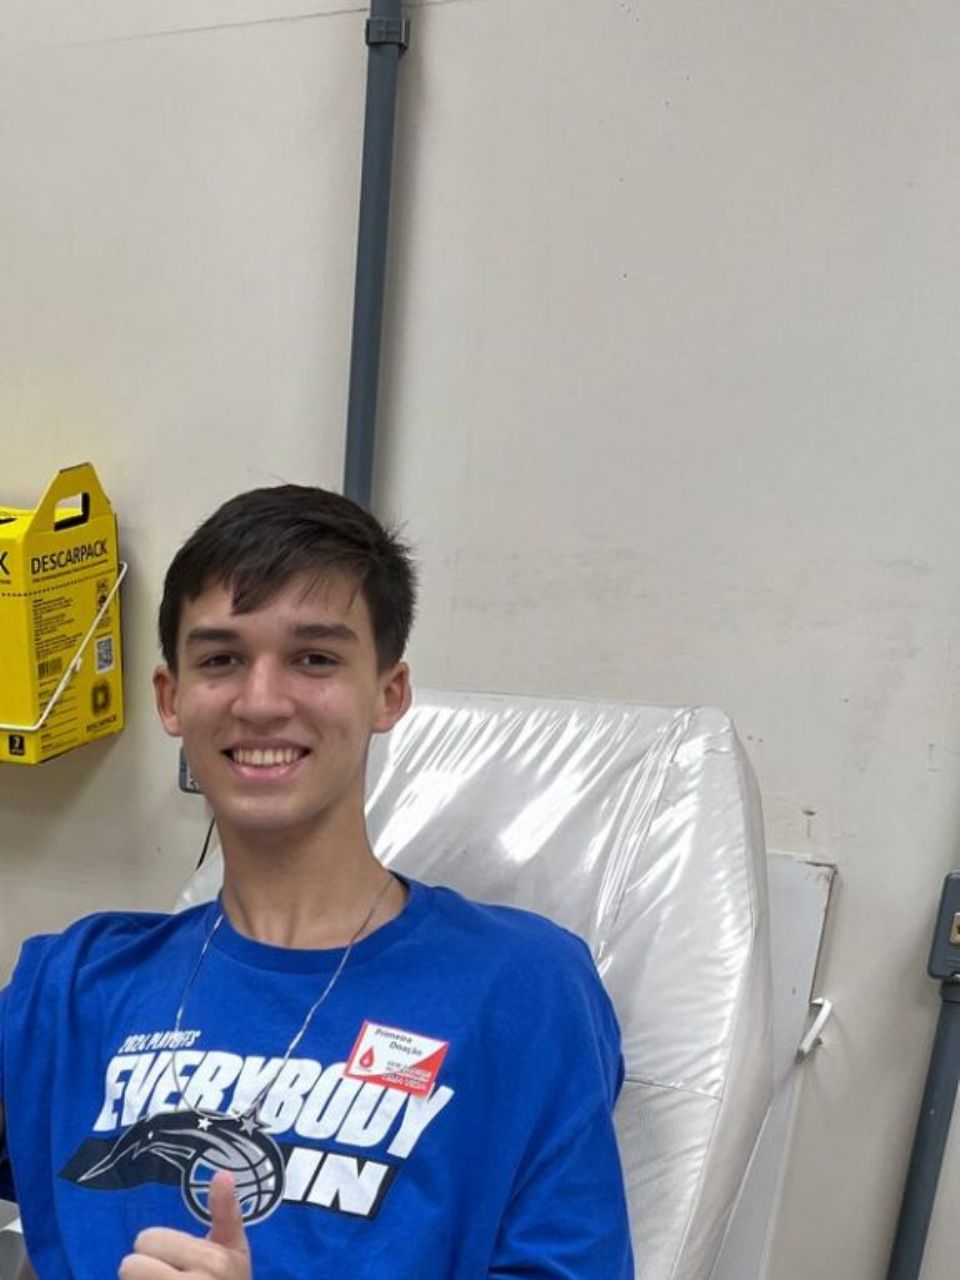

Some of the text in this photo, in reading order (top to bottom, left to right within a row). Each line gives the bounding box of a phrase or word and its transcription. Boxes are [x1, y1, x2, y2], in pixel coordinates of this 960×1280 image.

[31, 539, 108, 575] DESCARPACK
[93, 1050, 454, 1159] EVERYBODY
[282, 1147, 389, 1216] IN
